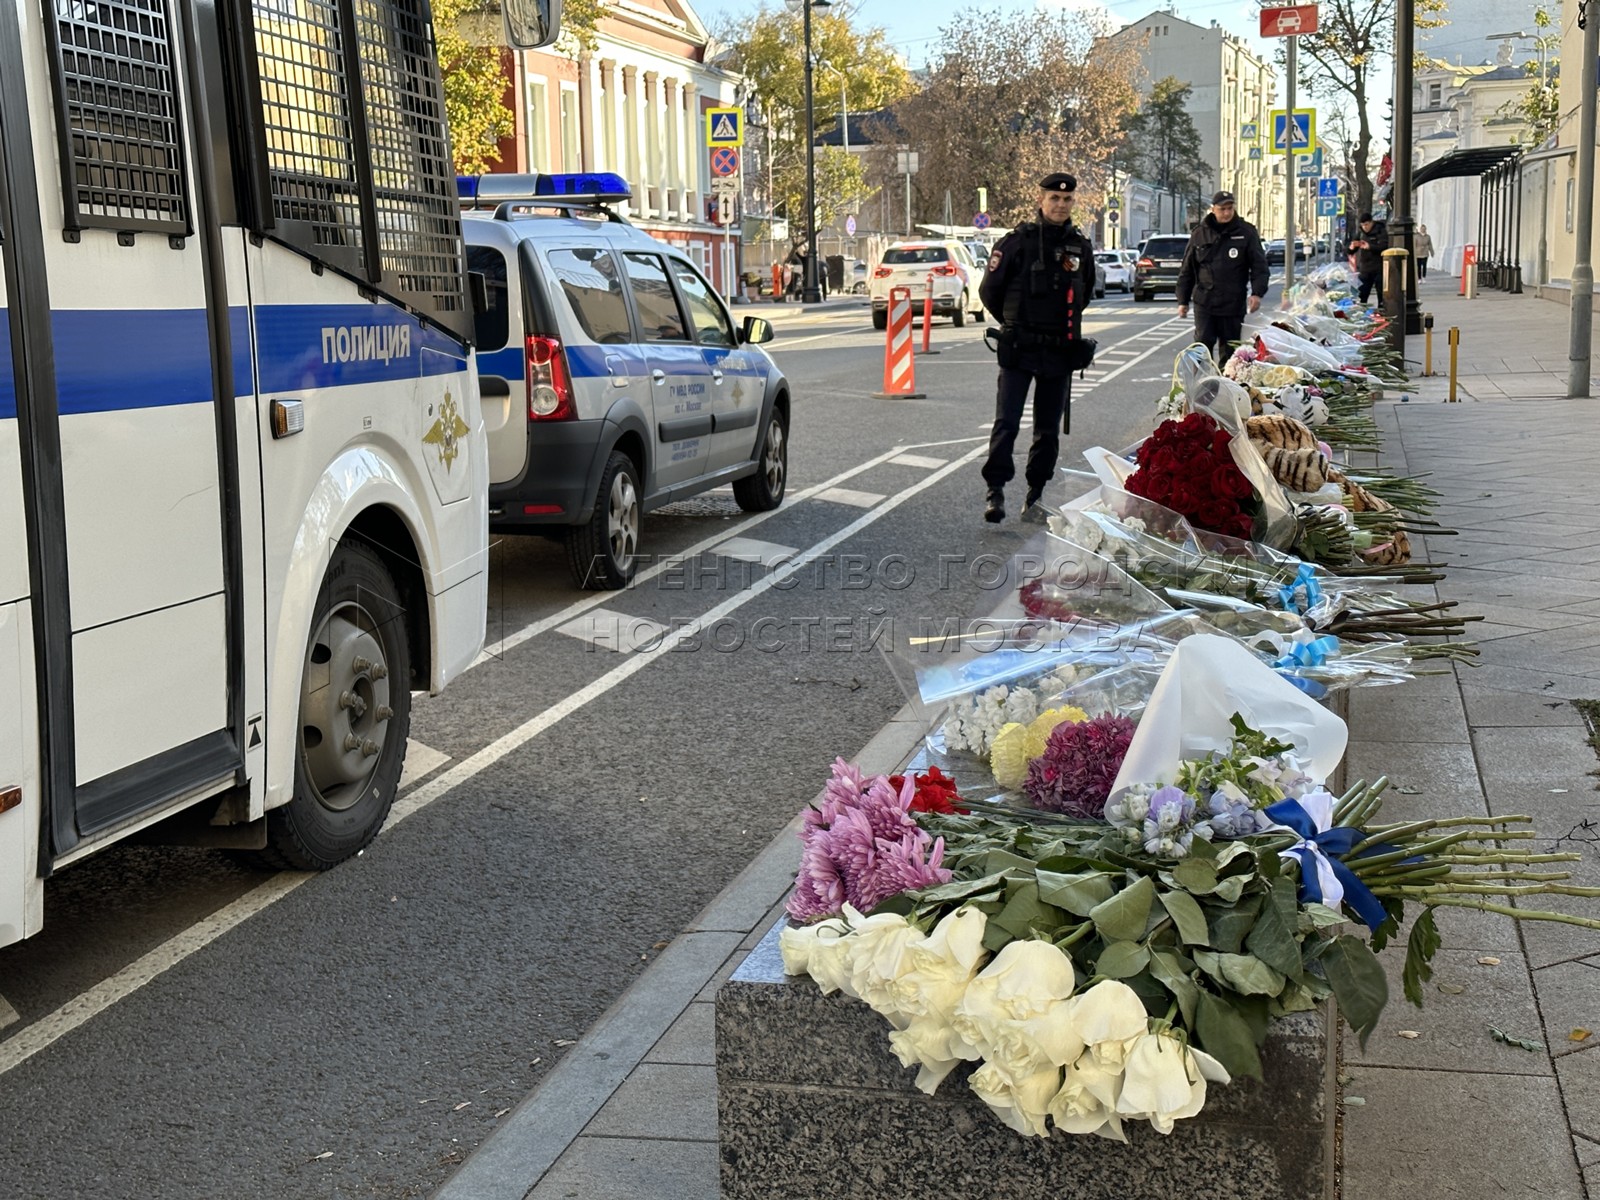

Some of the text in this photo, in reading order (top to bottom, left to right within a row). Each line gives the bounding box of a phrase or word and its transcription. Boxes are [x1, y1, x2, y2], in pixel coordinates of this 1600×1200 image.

[1323, 201, 1334, 215] P
[321, 325, 411, 366] ПОЛИЦИЯ
[676, 384, 688, 398] МВД
[688, 383, 705, 395] РОССИИ
